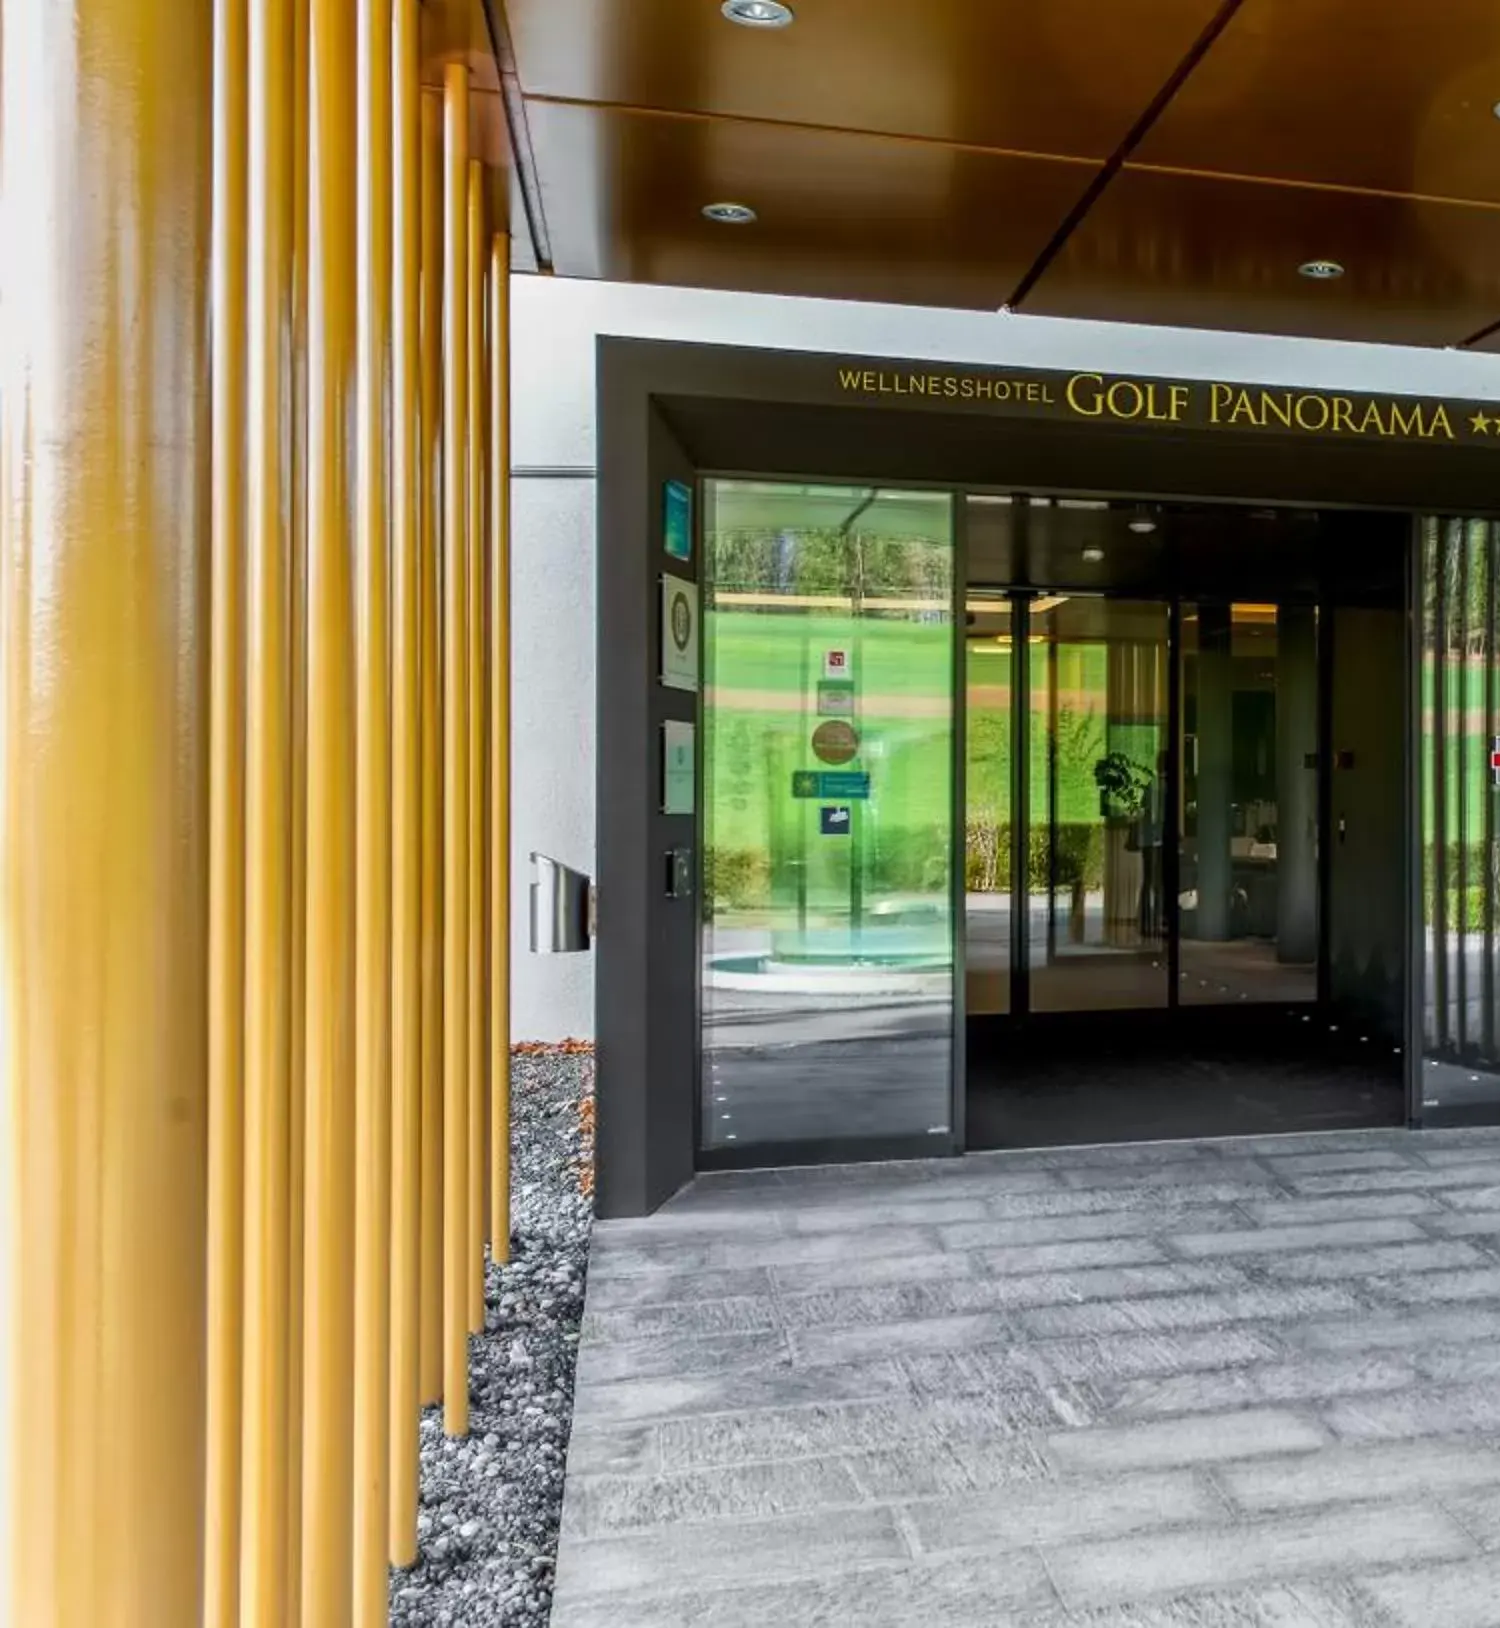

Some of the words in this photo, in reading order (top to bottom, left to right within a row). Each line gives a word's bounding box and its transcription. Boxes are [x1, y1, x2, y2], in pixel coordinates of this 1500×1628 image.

[839, 369, 1055, 403] WELLNESSHOTEL
[1066, 373, 1189, 421] GOLF
[1210, 383, 1454, 439] PANORAMA
